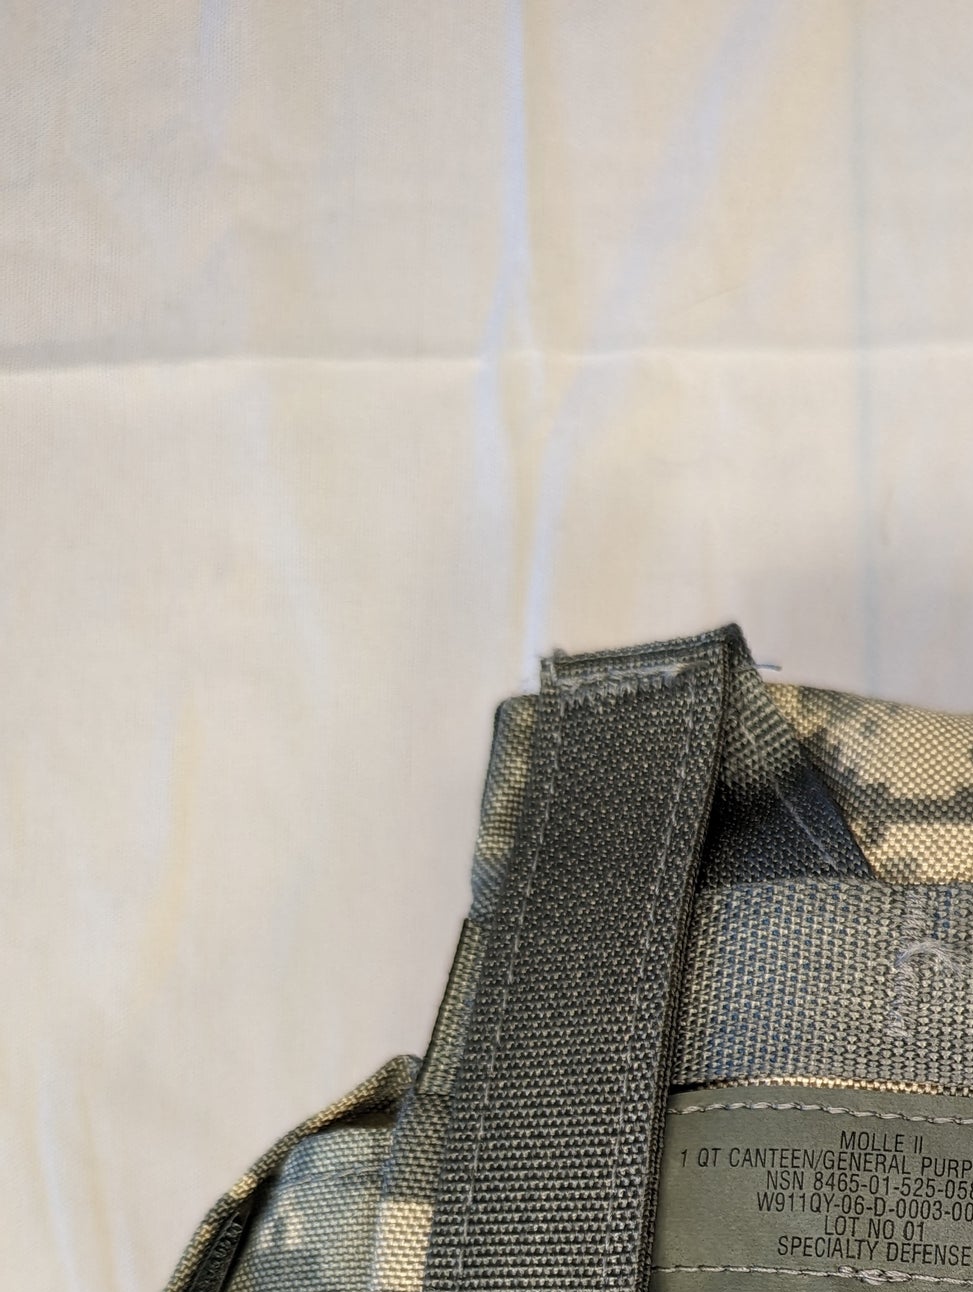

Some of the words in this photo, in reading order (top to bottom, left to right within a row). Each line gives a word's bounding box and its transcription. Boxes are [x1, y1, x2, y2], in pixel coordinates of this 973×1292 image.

[840, 1130, 905, 1153] MOLLE
[914, 1135, 923, 1154] II
[681, 1149, 688, 1167] 1
[697, 1148, 721, 1168] QT
[729, 1147, 911, 1175] CANTEEN/GENERAL
[766, 1170, 804, 1191] NSN
[824, 1215, 860, 1236] LOT
[868, 1218, 895, 1240] NO
[903, 1221, 925, 1242] 01
[777, 1235, 880, 1261] SPECIALTY
[886, 1242, 972, 1266] DEFENSE
